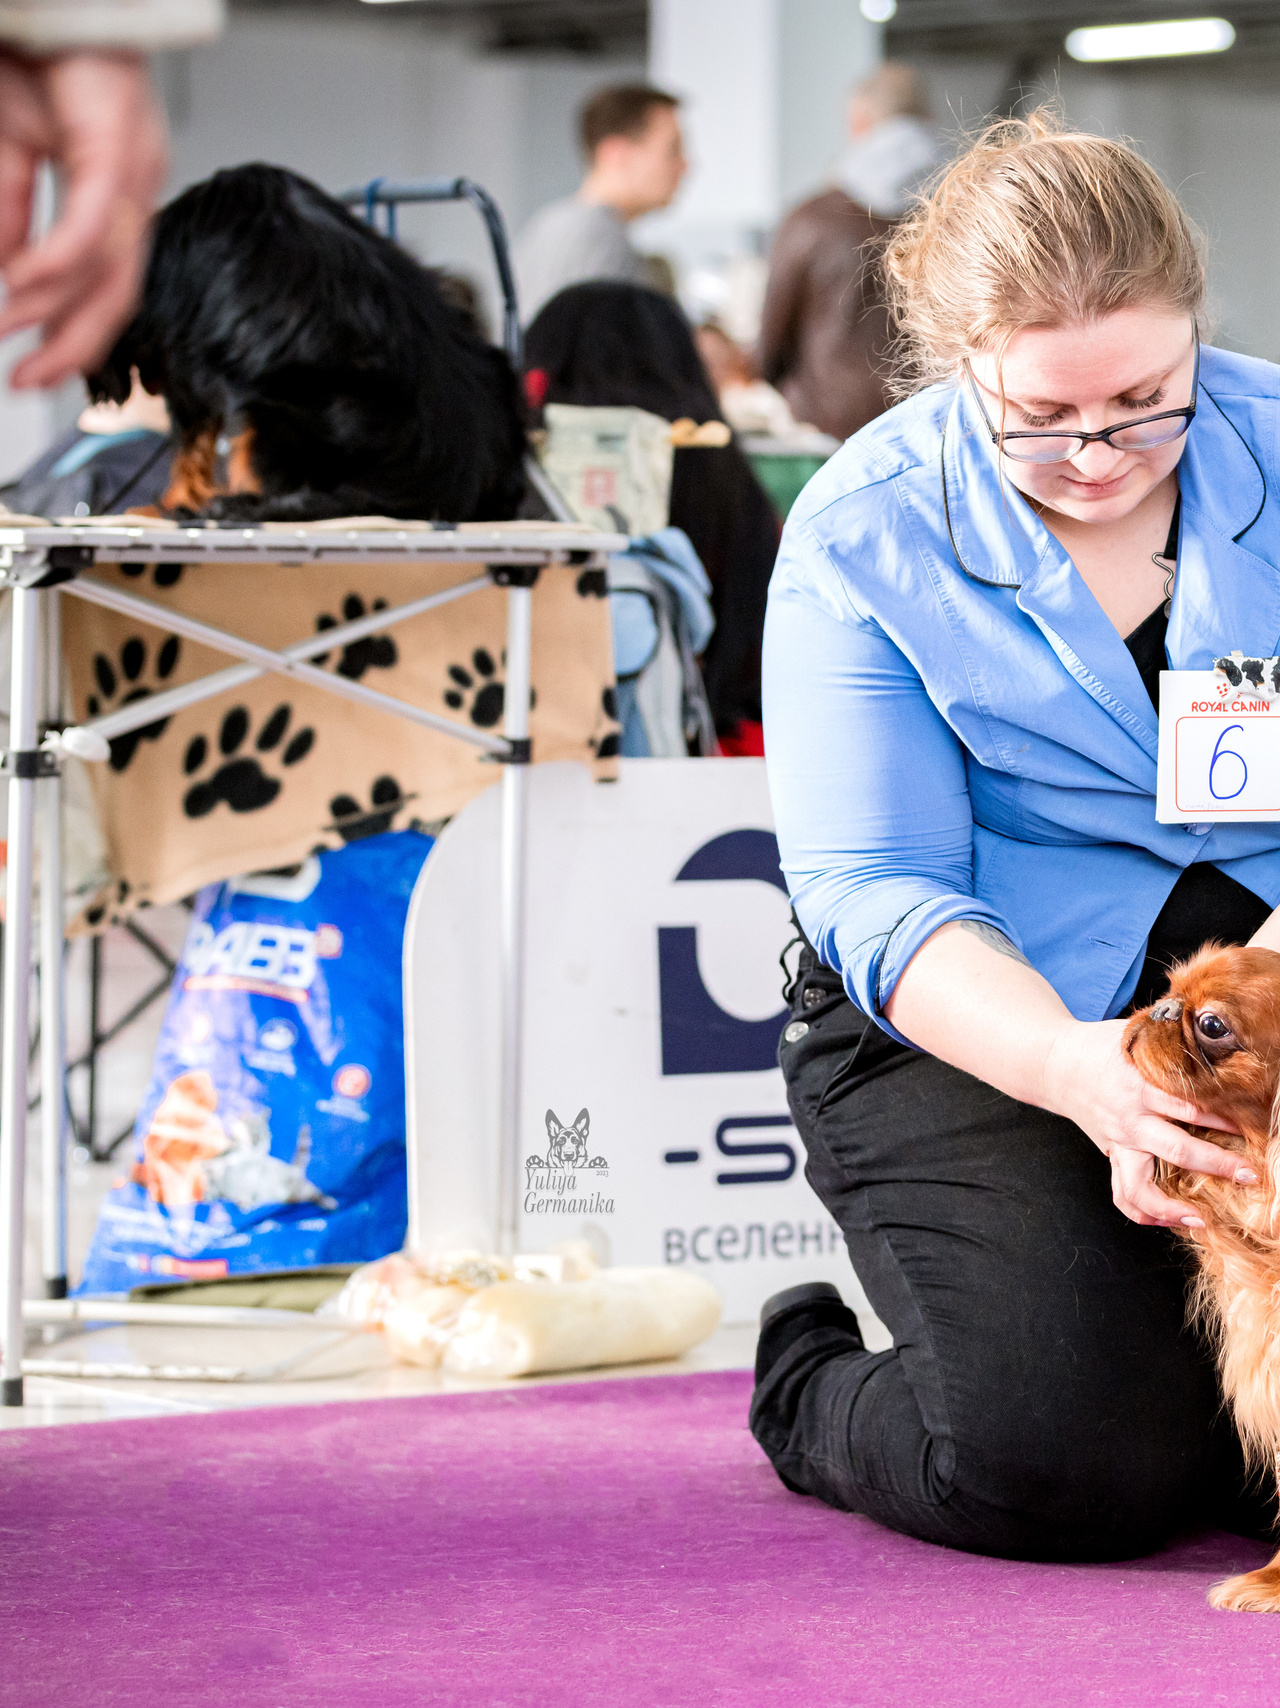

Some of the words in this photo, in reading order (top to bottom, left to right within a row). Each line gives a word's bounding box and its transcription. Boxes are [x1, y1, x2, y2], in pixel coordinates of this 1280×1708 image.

[1191, 701, 1228, 712] ROYAL
[1231, 701, 1270, 712] CANIN
[1209, 724, 1248, 800] 6
